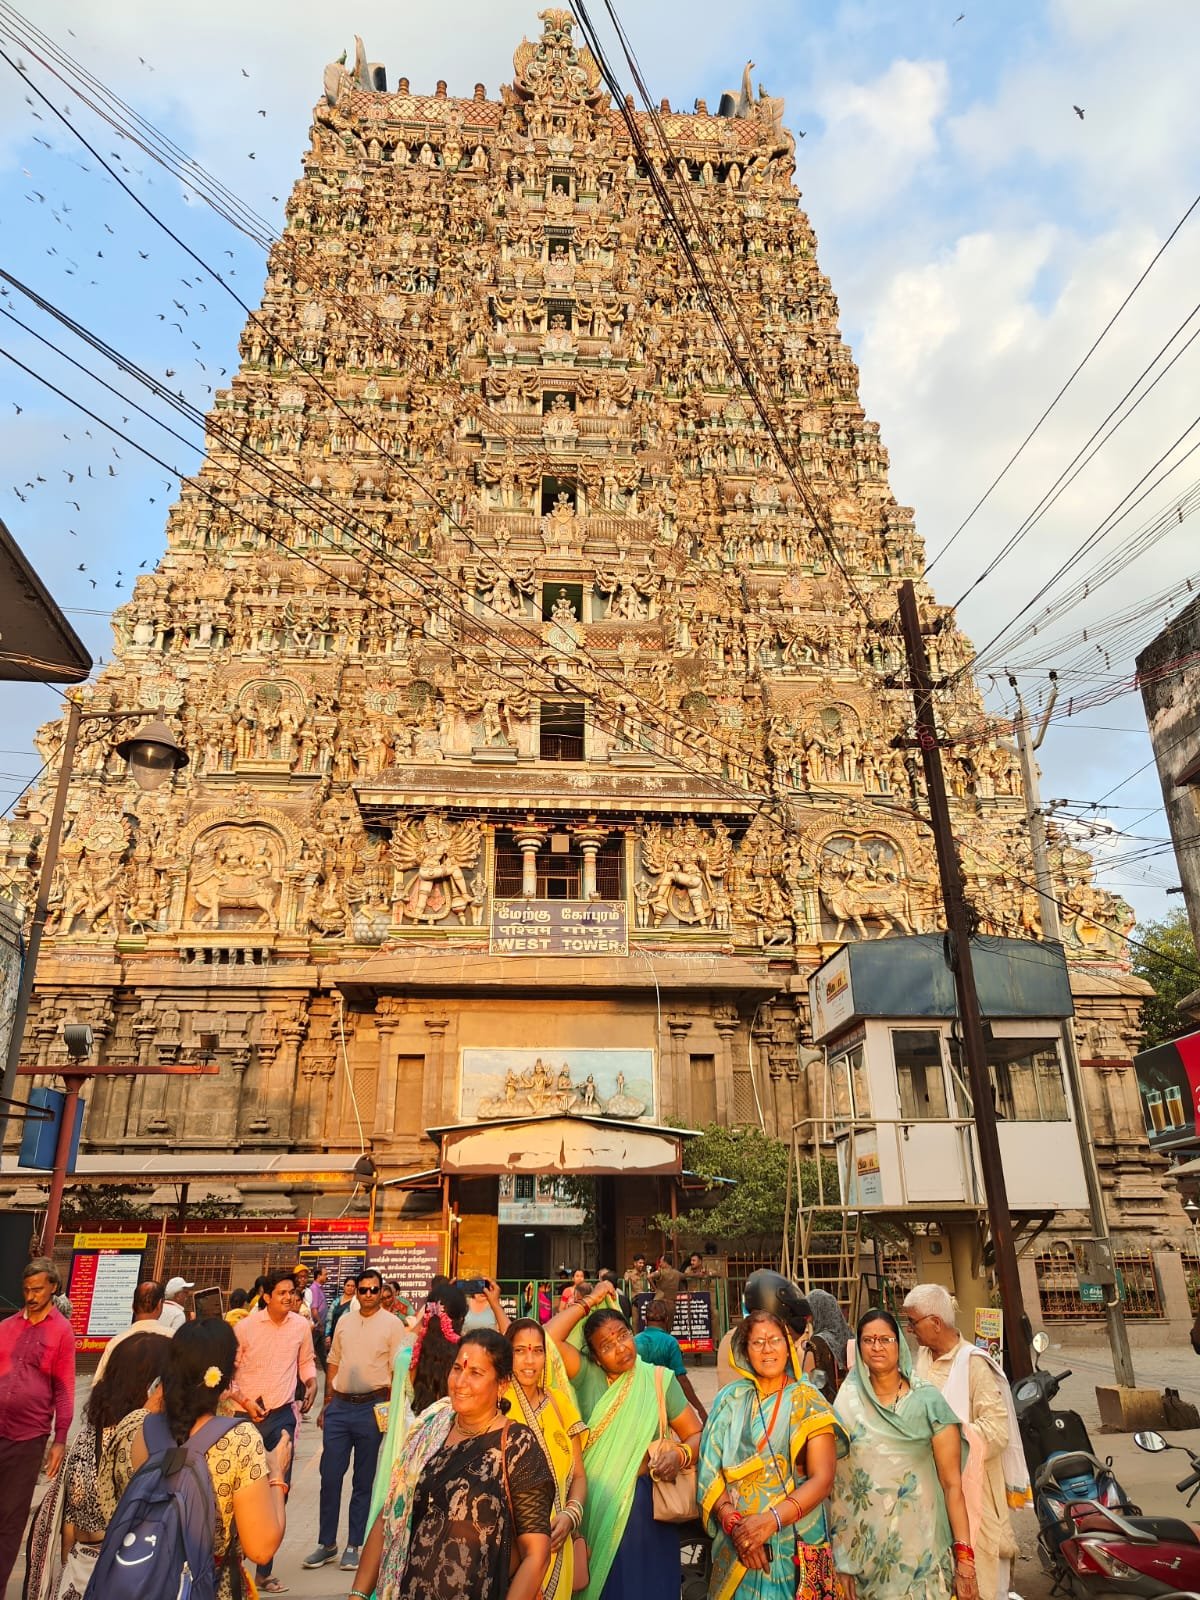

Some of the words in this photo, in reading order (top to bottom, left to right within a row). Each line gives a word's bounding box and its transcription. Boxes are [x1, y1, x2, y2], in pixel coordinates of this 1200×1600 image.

[499, 906, 551, 922] மேற்கு
[561, 907, 619, 922] கோபுரம்
[498, 922, 552, 936] पश्चिम
[560, 923, 619, 938] गोपुर
[497, 938, 552, 950] WEST
[561, 939, 619, 951] TOWER
